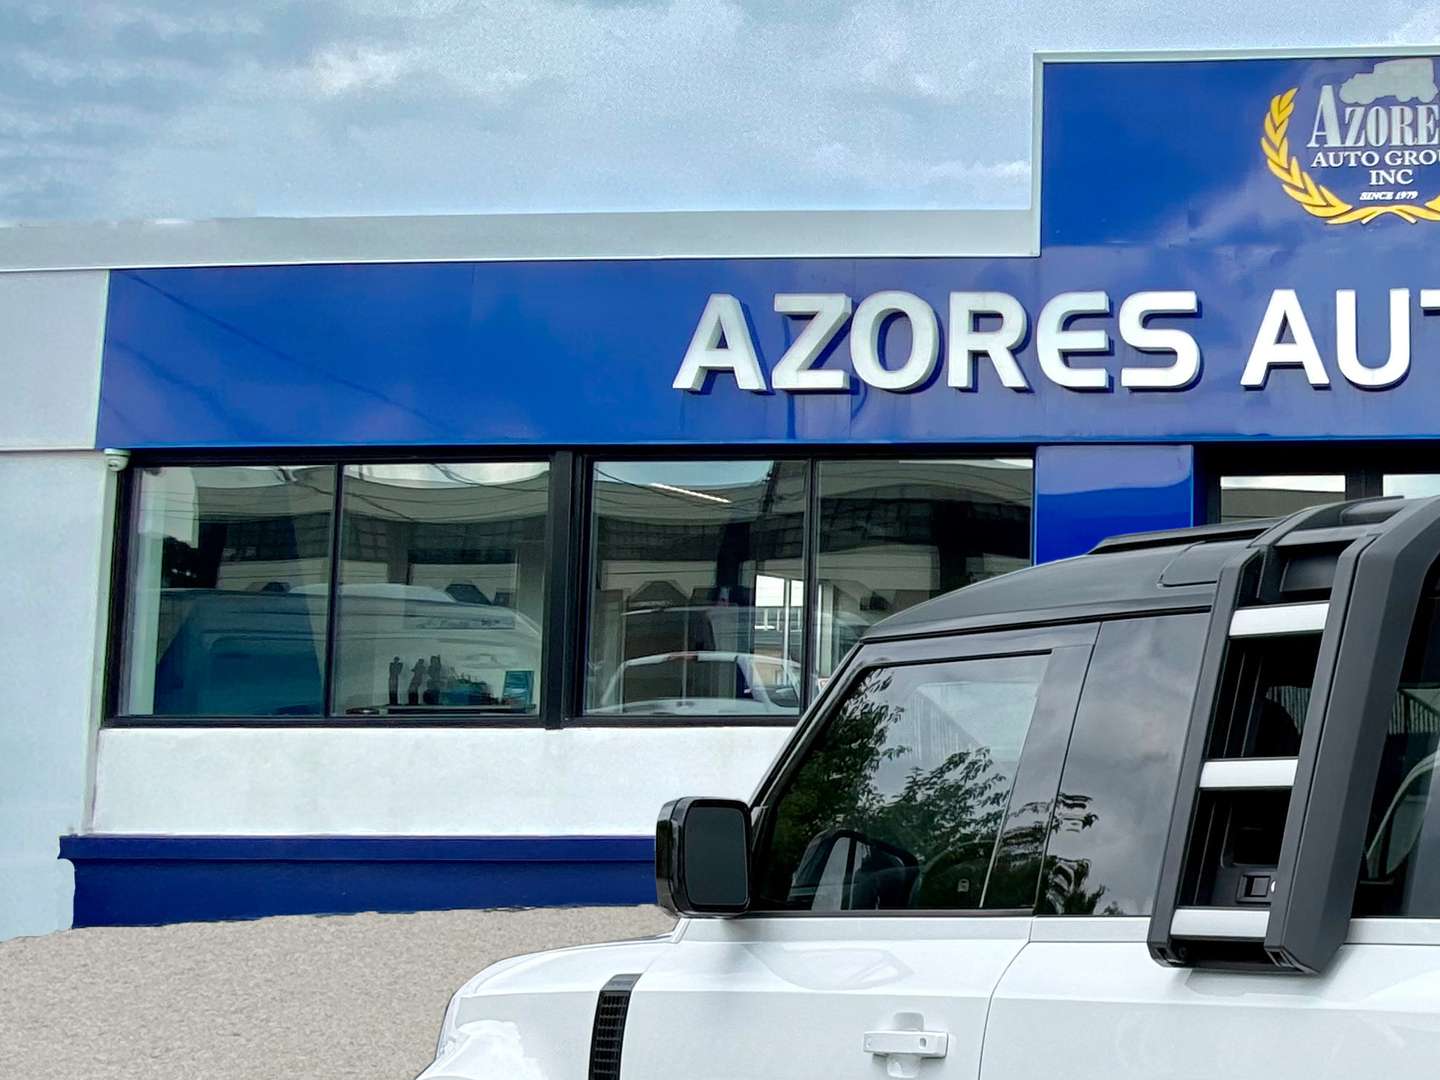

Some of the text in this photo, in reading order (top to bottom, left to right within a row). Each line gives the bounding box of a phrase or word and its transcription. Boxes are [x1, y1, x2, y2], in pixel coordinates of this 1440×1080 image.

[1311, 151, 1380, 168] AUTO
[1369, 169, 1414, 185] INC
[1359, 190, 1419, 201] SINCE 1979
[673, 291, 1200, 393] AZORES
